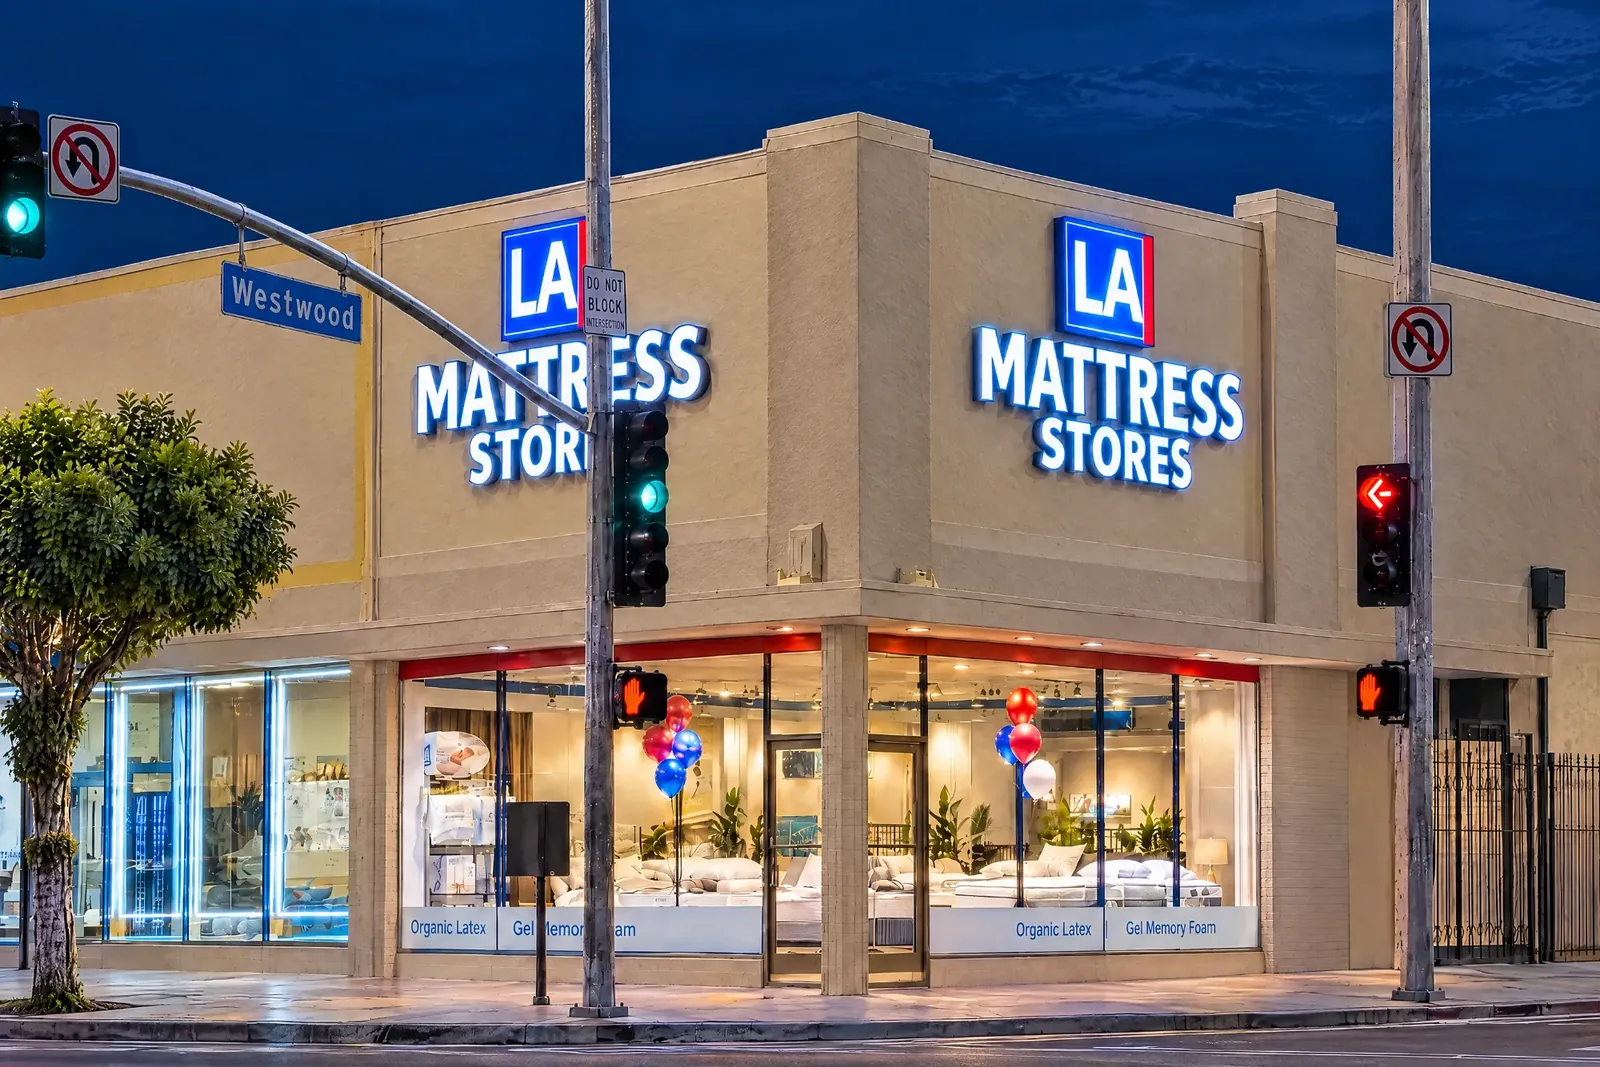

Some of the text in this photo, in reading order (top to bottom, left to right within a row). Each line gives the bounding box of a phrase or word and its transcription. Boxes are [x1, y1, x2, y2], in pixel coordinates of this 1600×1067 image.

[511, 240, 578, 318] LA
[587, 276, 623, 293] DO NOT
[1074, 240, 1143, 323] LA
[231, 275, 354, 330] Westwood
[588, 297, 623, 314] BLOCK
[586, 317, 625, 330] INTERSECTION
[975, 326, 1244, 441] MATTRESS
[469, 423, 588, 486] STOR
[1038, 418, 1193, 490] STORES
[410, 919, 487, 938] Organic Latex
[513, 920, 636, 937] Gel emor am
[1016, 921, 1092, 940] Organic Latex
[1126, 920, 1216, 938] Gel Memory Foam
